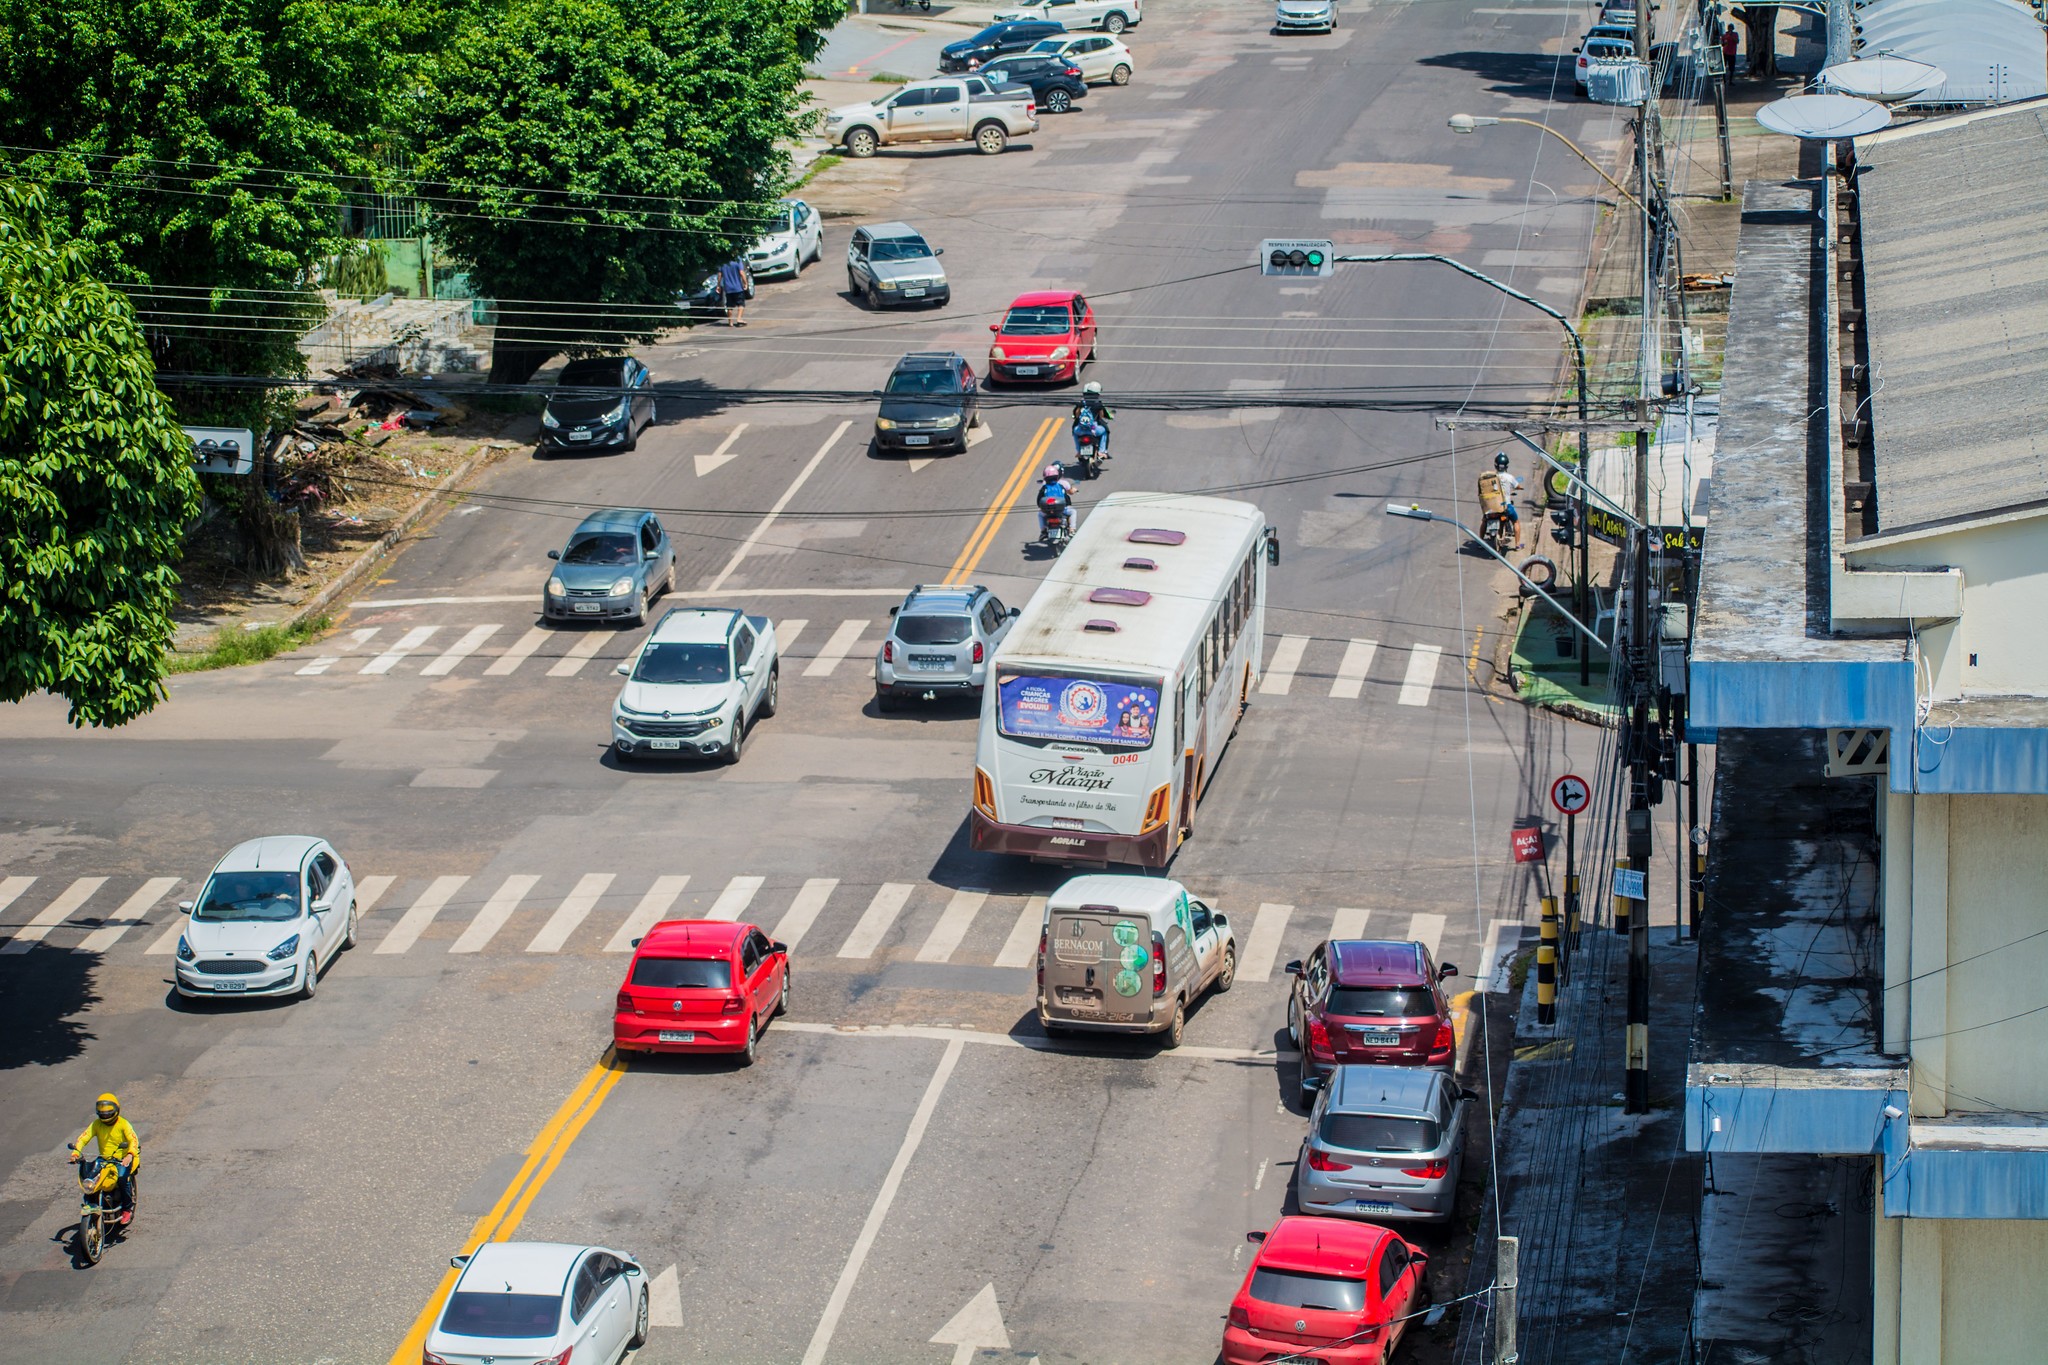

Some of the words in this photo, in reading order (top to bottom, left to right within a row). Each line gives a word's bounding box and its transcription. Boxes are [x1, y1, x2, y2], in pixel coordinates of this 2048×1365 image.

[1664, 531, 1700, 549] Sabr
[1020, 690, 1051, 698] CRIANÇAS
[1019, 702, 1050, 711] EVOLUIU
[1112, 754, 1138, 764] 0040
[1063, 766, 1105, 778] Viação
[1029, 769, 1114, 791] Macapá
[1020, 795, 1067, 807] Transportando
[1076, 800, 1094, 810] filhos
[1105, 803, 1116, 811] Rei
[1050, 837, 1086, 846] AGRALE
[1054, 938, 1103, 951] BERNACOM
[1079, 1009, 1134, 1021] 3222-2164
